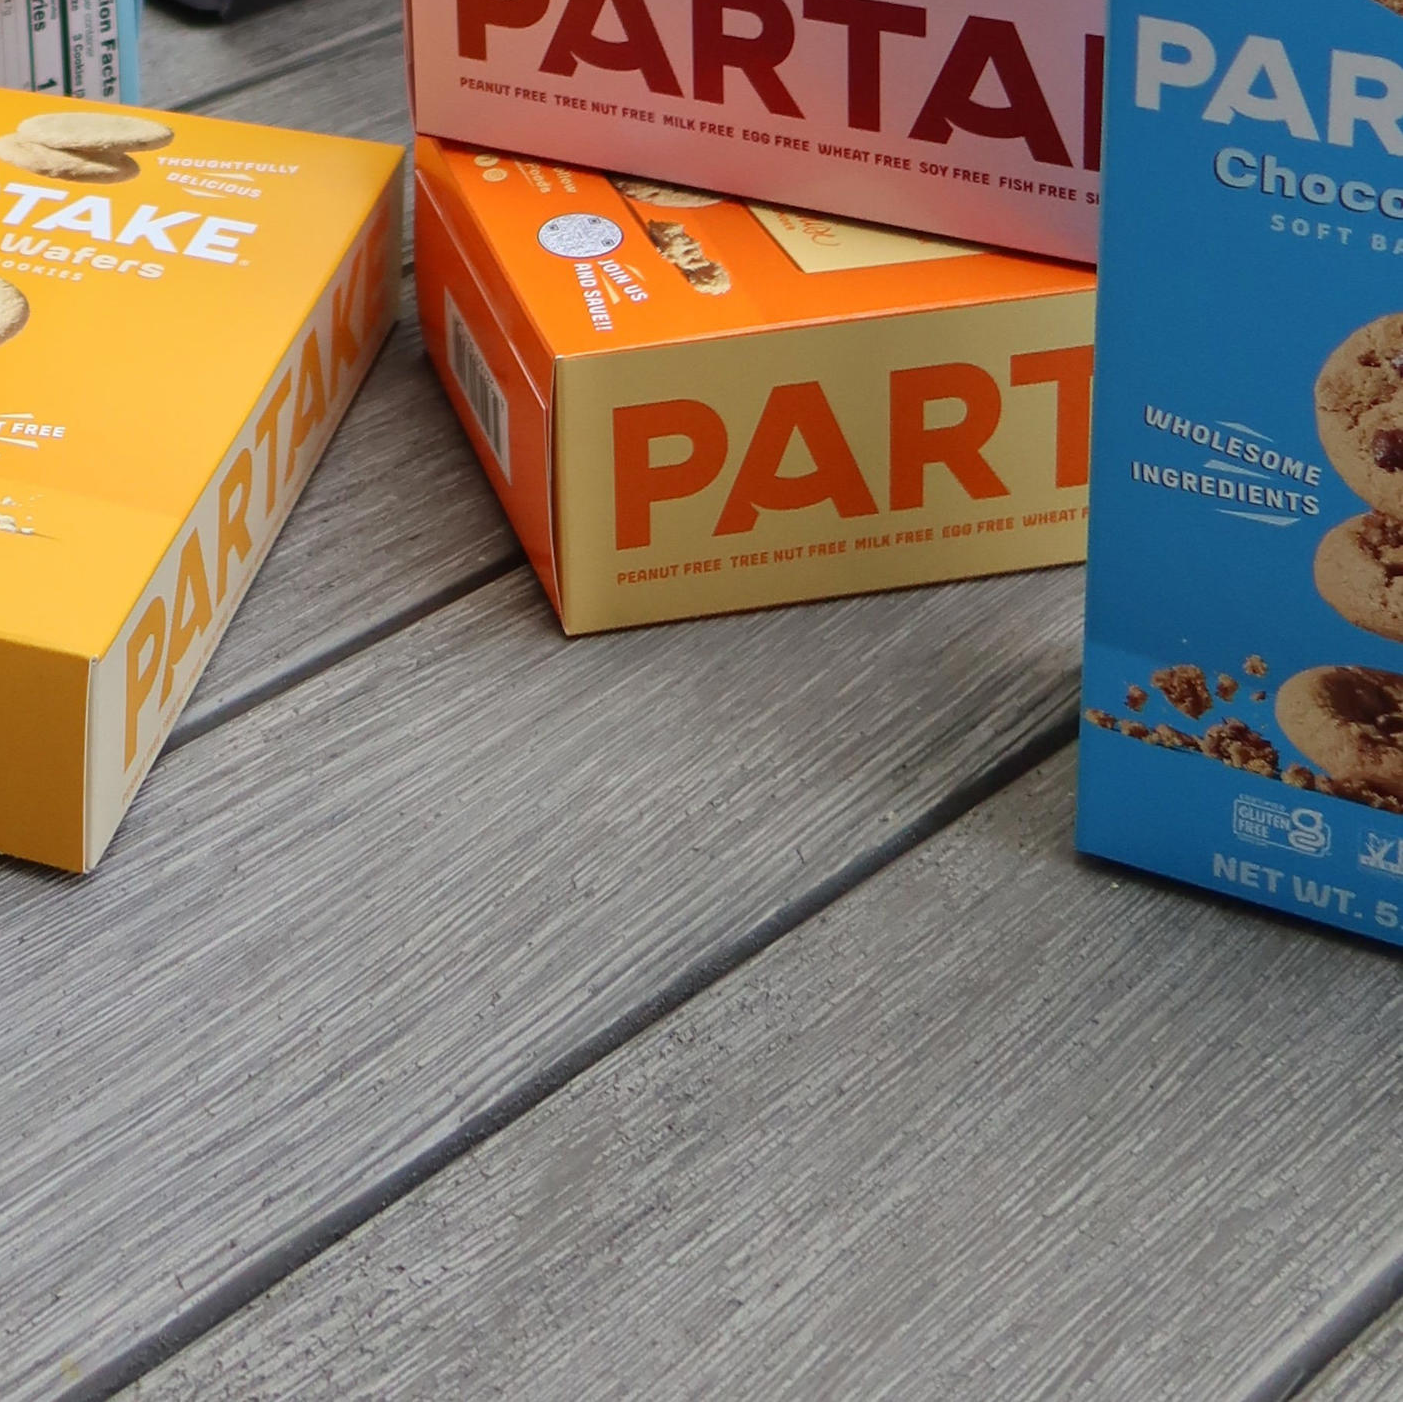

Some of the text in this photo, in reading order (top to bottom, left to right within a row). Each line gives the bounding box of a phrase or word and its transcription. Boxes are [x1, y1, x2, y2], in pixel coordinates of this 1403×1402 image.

[74, 44, 84, 86] Cookies
[101, 39, 117, 97] Facts
[459, 76, 511, 97] PEANUT
[515, 86, 548, 104] FREE
[554, 94, 587, 112] TREE
[591, 101, 618, 117] NUT
[622, 107, 656, 124] FREE
[663, 114, 696, 132] MILK
[700, 121, 735, 139] FREE
[742, 129, 770, 146] EGG
[774, 135, 810, 152] FREE
[818, 142, 870, 163] WHEAT
[874, 153, 911, 171] FREE
[919, 160, 948, 178] SOY
[952, 167, 991, 186] FREE
[998, 175, 1034, 194] FISH
[1038, 184, 1077, 202] FREE
[157, 156, 300, 175] THOUGHTFULLY
[166, 171, 263, 200] DELICIOUS
[1270, 213, 1353, 246] SOFT
[573, 261, 614, 332] AND SAVE!!
[597, 258, 648, 302] JOIN US
[10, 422, 66, 439] FREE
[1144, 404, 1323, 487] WHOLESOME
[123, 200, 392, 774] PARTAKE
[1130, 460, 1320, 516] INGREDIENTS
[616, 564, 680, 586] PEANUT
[683, 558, 722, 576] FREE
[730, 551, 769, 569] TREE
[773, 546, 804, 563] NUT
[808, 540, 847, 557] FREE
[854, 534, 890, 551] MILK
[895, 528, 934, 545] FREE
[941, 523, 972, 539] EGG
[976, 517, 1014, 534] FREE
[1022, 507, 1077, 528] WHEAT
[1237, 804, 1291, 830] GLUTEN
[1237, 820, 1270, 838] FREE
[1212, 852, 1285, 894] NET
[1292, 874, 1364, 919] WT.
